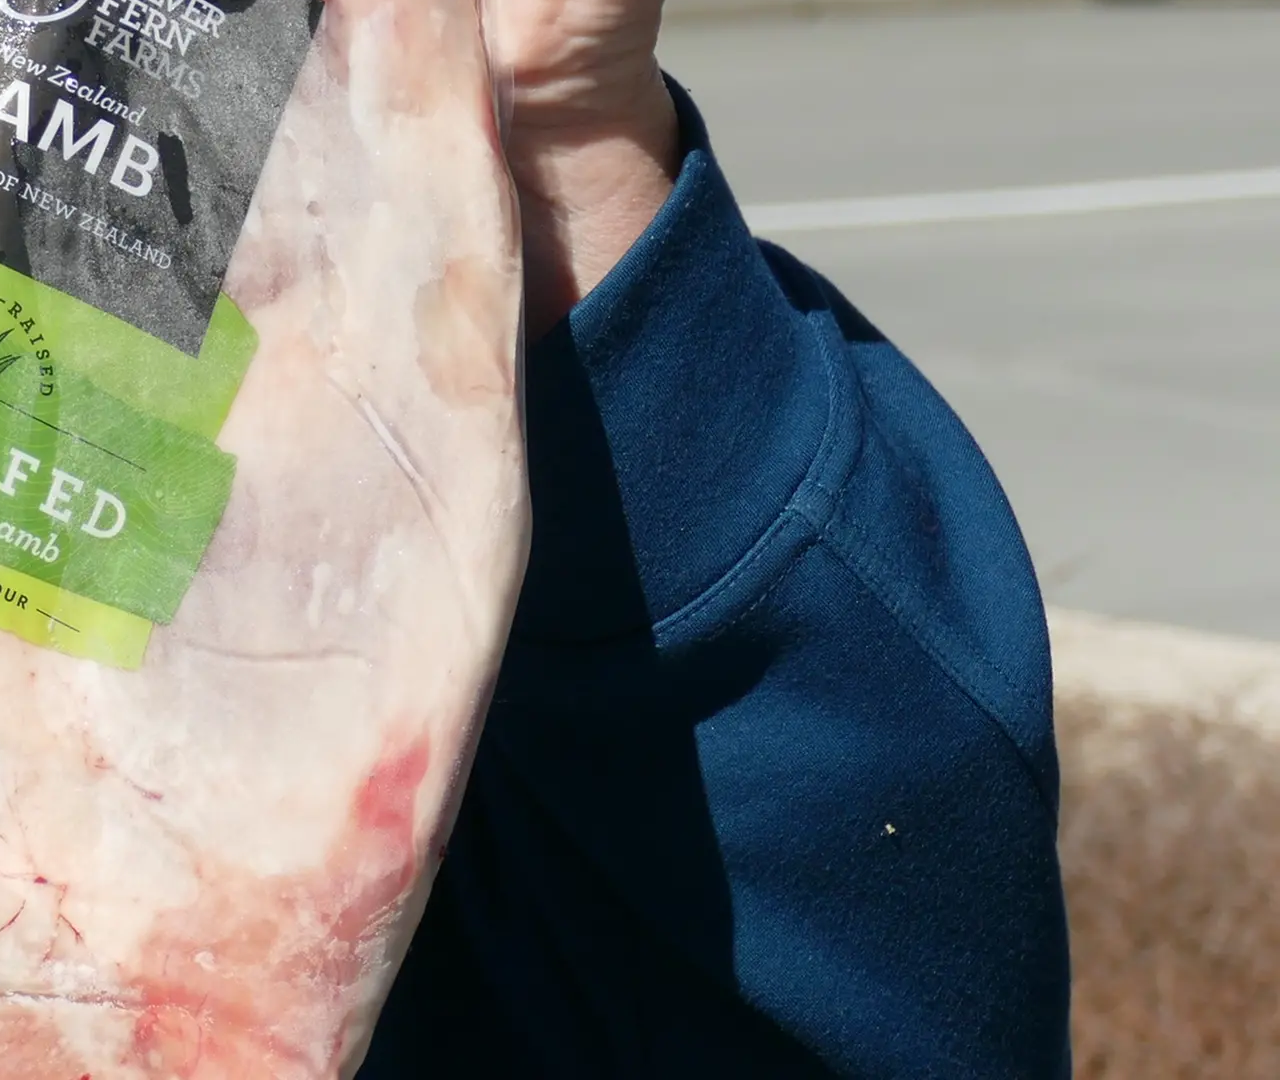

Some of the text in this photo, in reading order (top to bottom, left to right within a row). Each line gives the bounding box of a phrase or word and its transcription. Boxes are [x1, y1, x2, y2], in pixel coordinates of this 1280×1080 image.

[47, 65, 147, 126] Zealand
[84, 16, 206, 100] FARMS
[21, 183, 80, 221] NEW
[80, 214, 172, 271] ZEALAND
